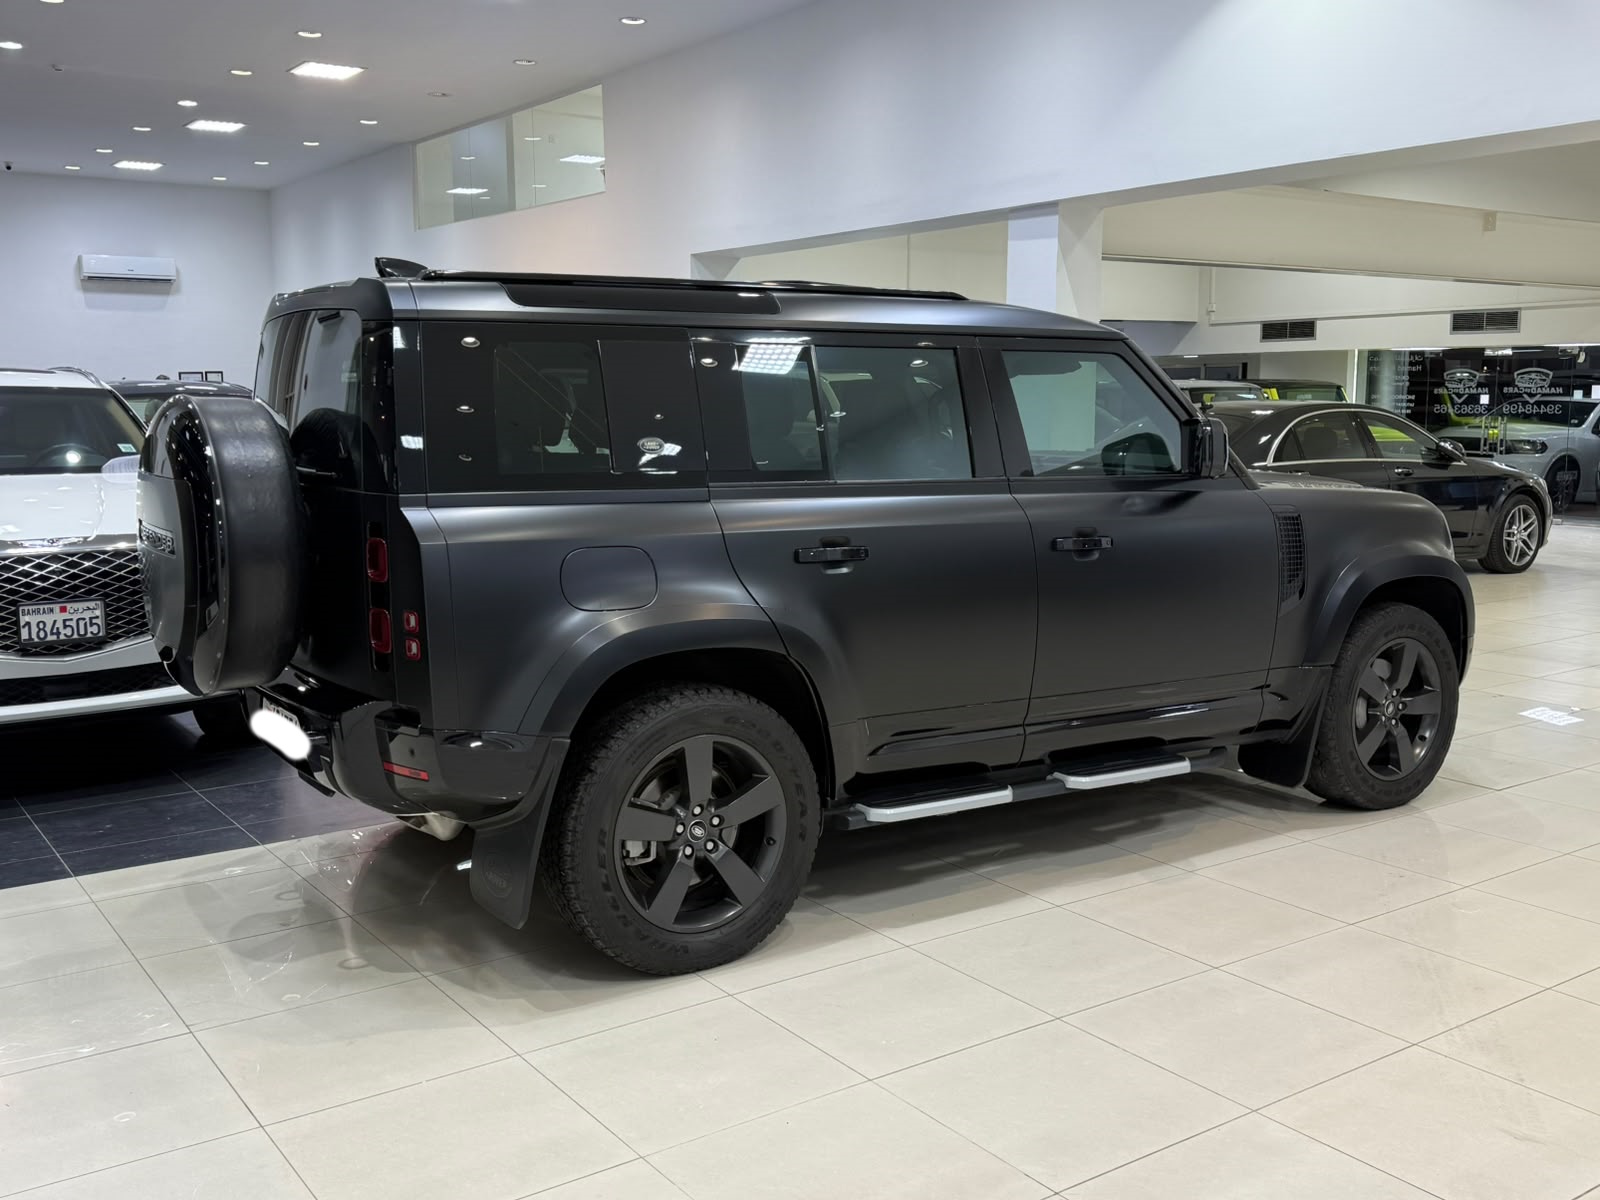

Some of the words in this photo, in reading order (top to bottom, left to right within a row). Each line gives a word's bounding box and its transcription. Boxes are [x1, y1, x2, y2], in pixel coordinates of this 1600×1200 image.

[21, 606, 54, 617] BAHRAIN
[68, 602, 100, 615] البحرين
[21, 615, 101, 642] 184505
